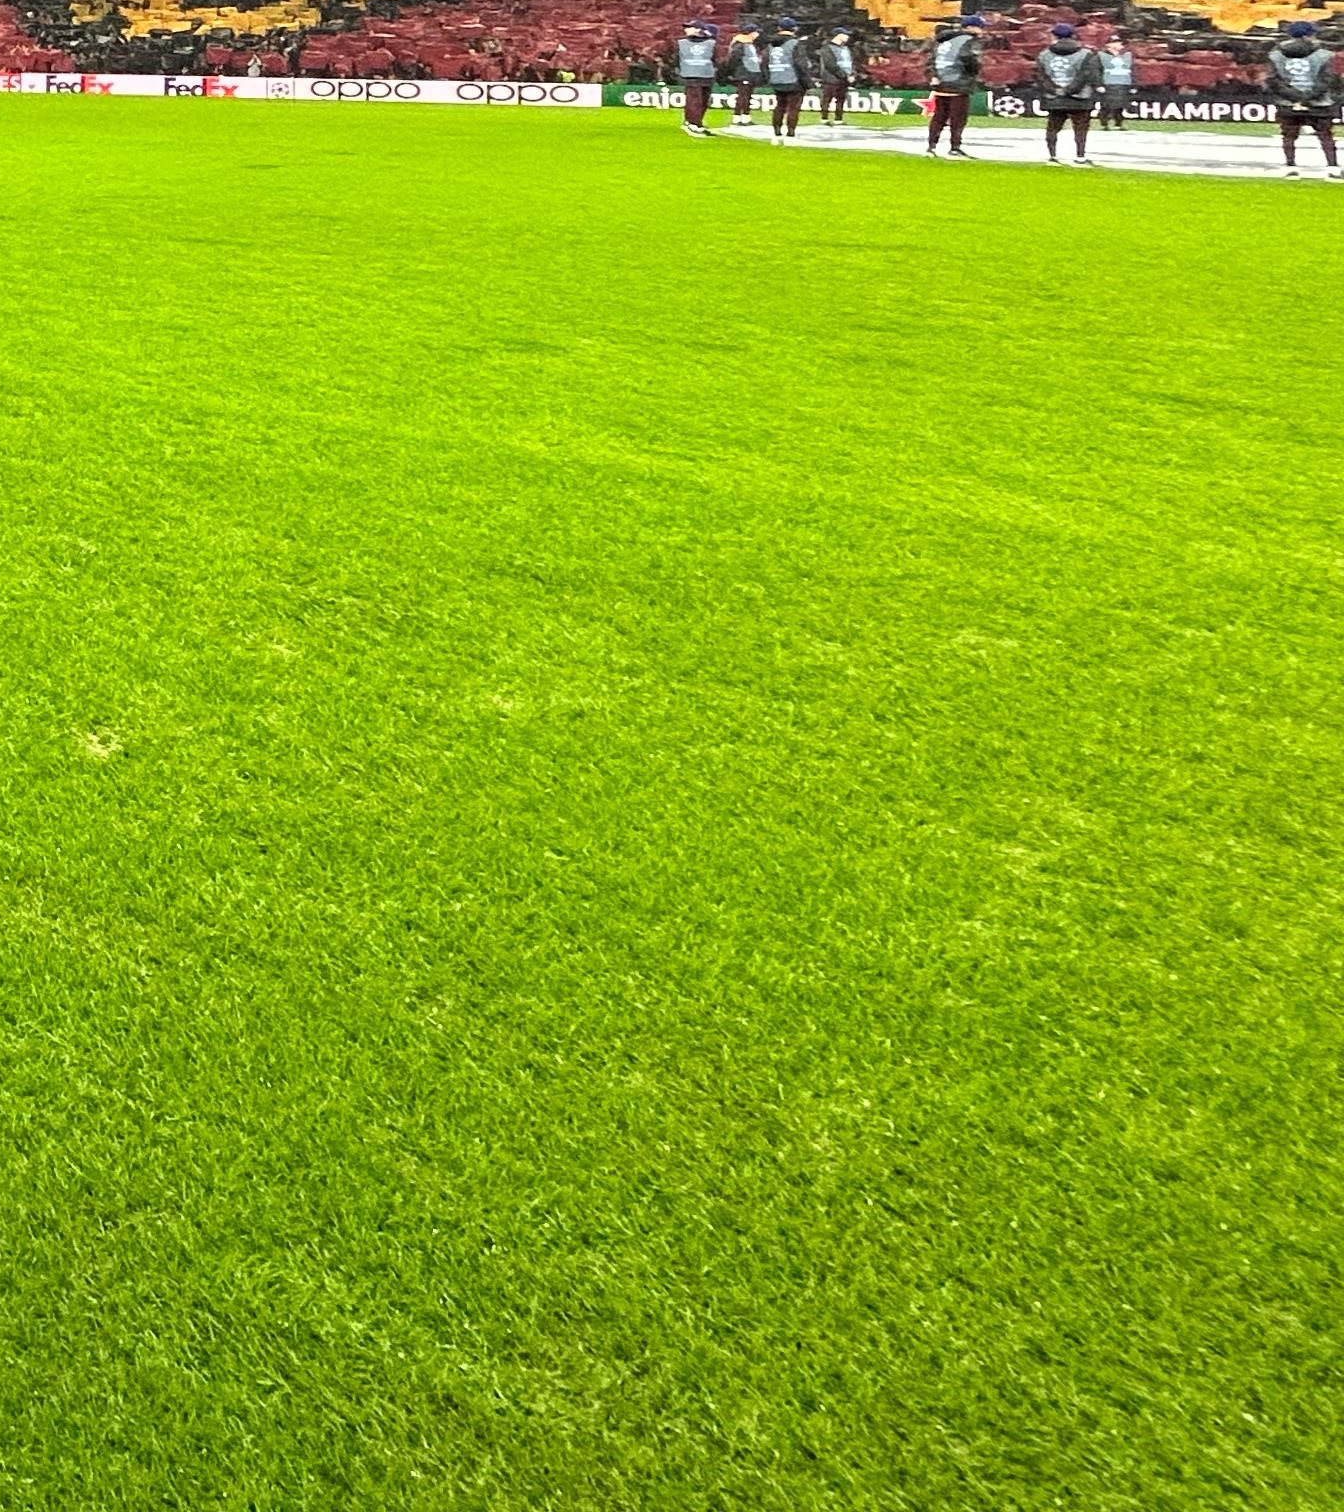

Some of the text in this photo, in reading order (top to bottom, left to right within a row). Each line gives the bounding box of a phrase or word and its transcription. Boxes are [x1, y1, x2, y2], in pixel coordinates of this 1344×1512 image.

[45, 74, 240, 97] FedEx FedEx
[310, 78, 580, 105] oppo oppo
[623, 82, 687, 110] enjo
